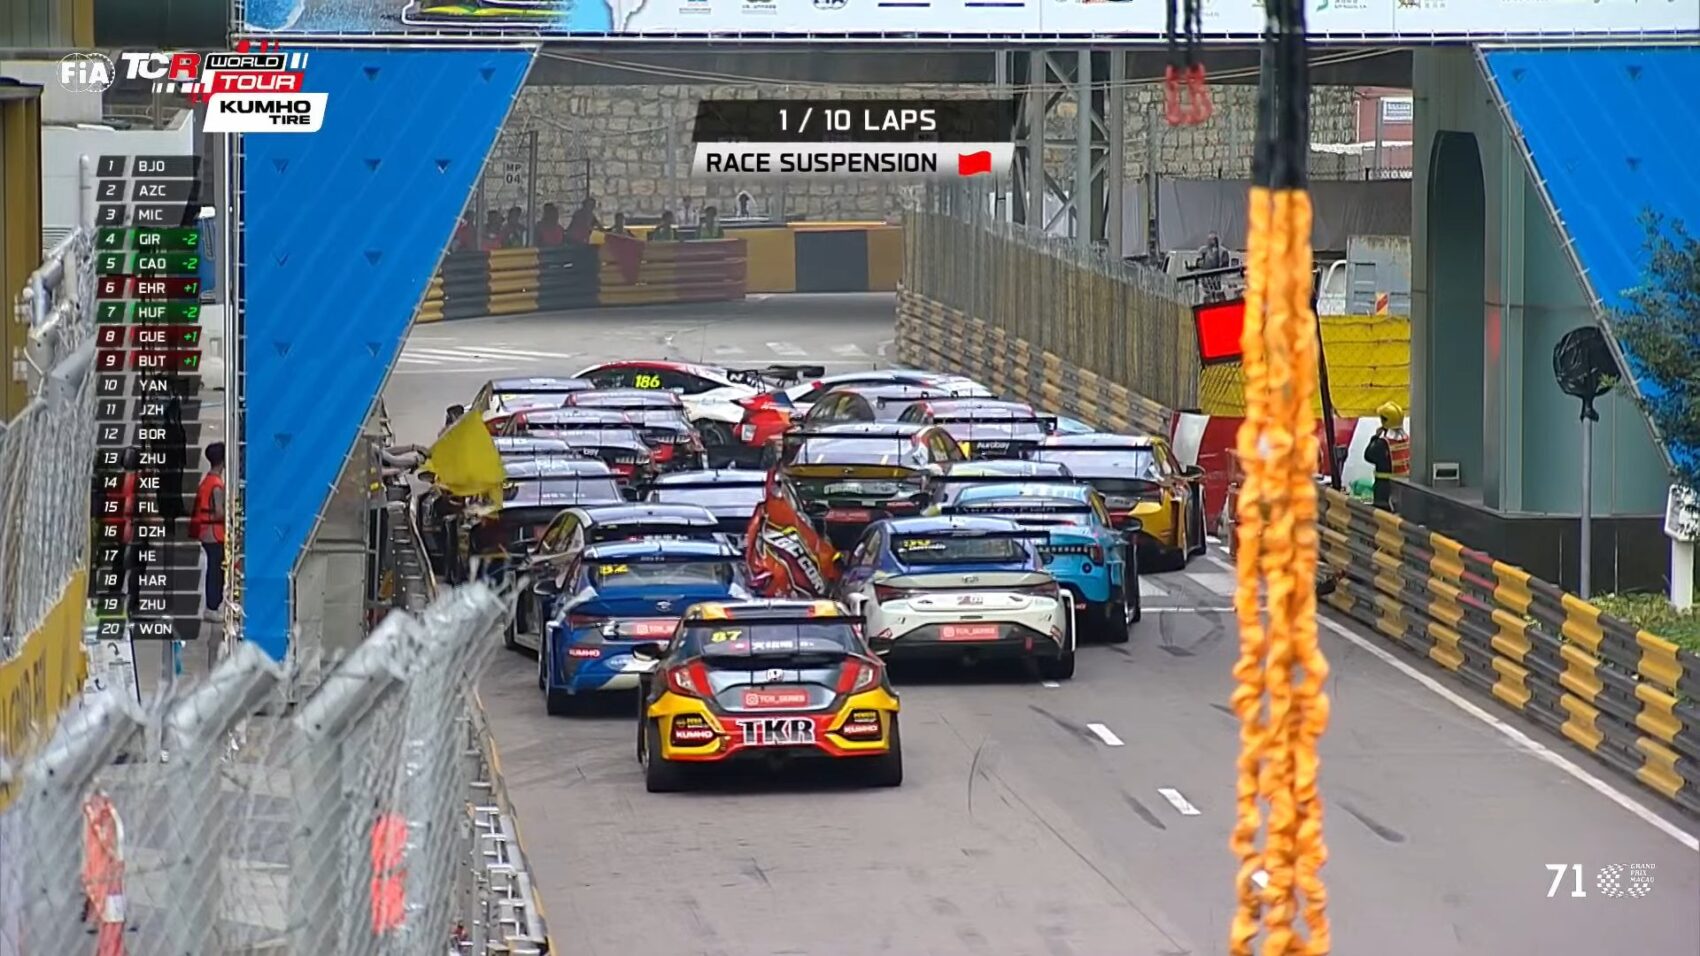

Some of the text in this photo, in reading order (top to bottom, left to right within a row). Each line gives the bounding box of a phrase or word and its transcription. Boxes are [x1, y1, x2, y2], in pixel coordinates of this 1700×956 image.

[506, 163, 521, 172] MP
[506, 173, 520, 184] 04
[634, 374, 661, 389] 186
[737, 717, 816, 746] TKR
[843, 723, 878, 734] KUMHO
[675, 730, 713, 739] KUMHO
